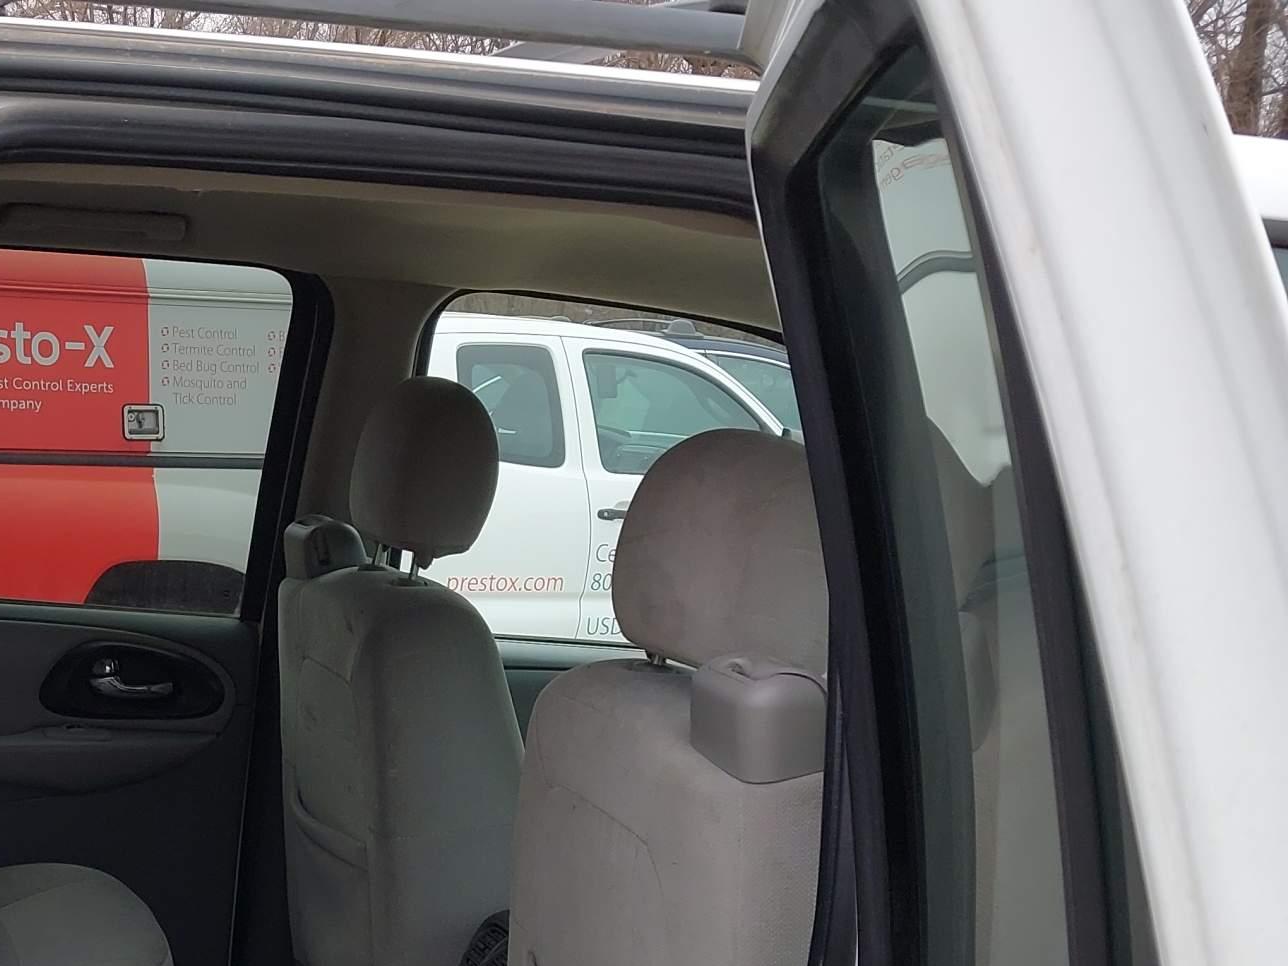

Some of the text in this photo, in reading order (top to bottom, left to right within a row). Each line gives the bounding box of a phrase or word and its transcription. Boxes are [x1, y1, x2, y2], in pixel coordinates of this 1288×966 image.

[172, 326, 238, 340] Pest Control
[172, 342, 256, 358] Termite Control
[172, 359, 260, 375] Bed Bug Control
[12, 377, 63, 392] Control
[67, 379, 115, 395] Experts
[173, 376, 247, 391] Mosquito and
[173, 392, 237, 406] Tick Control
[447, 575, 564, 592] prestox.com
